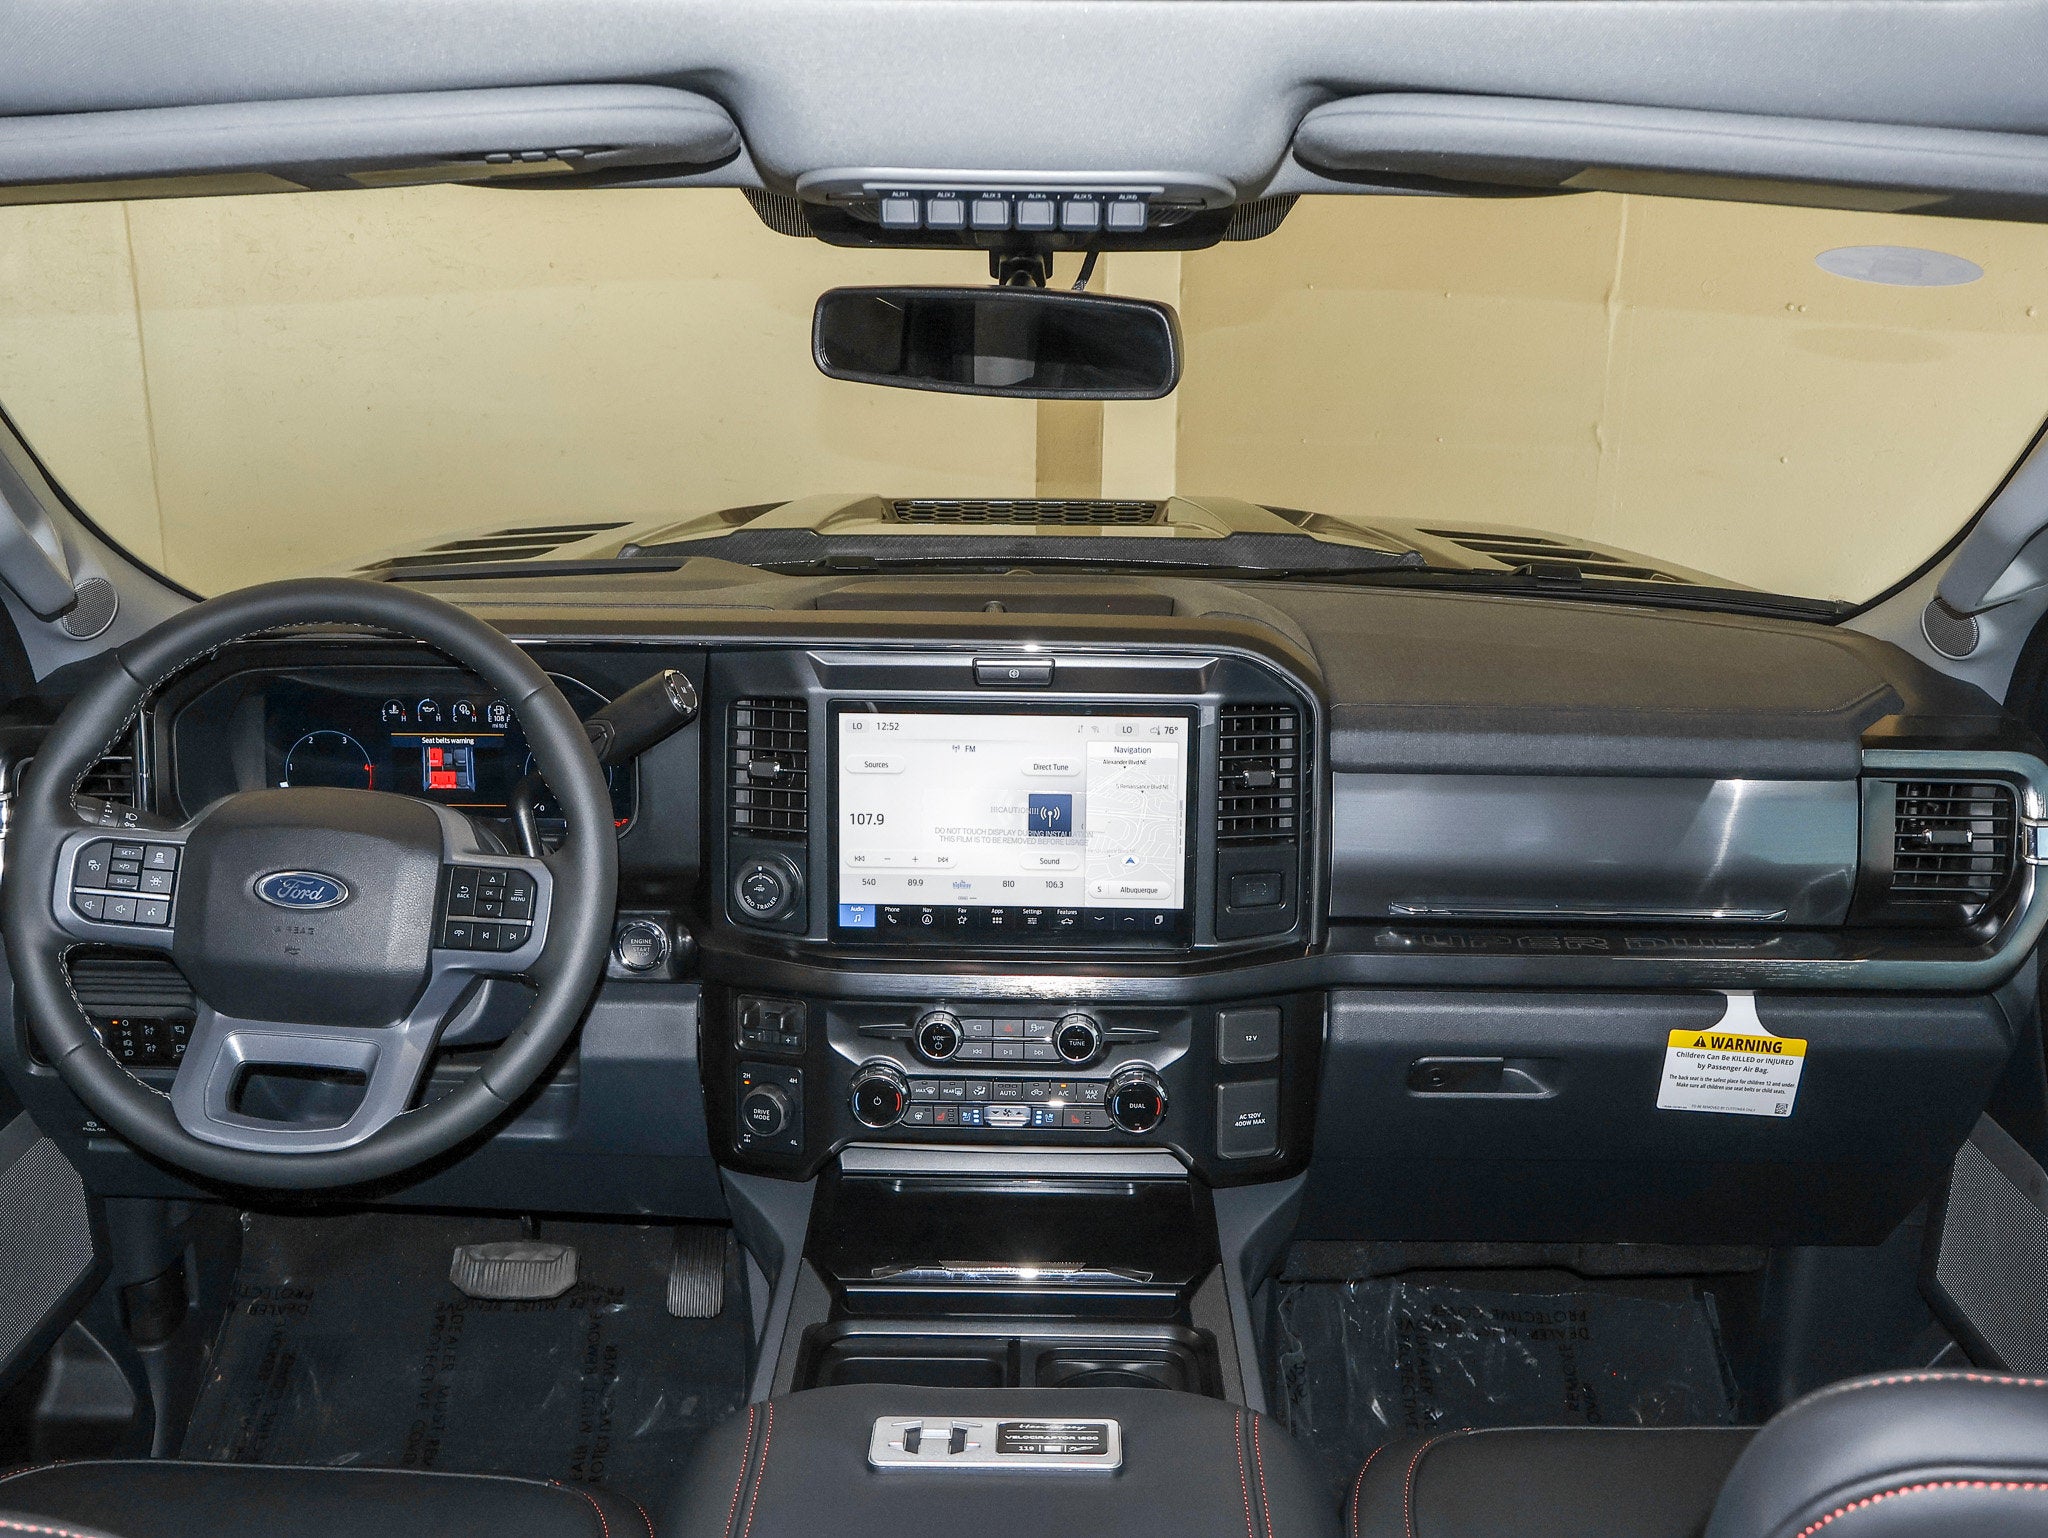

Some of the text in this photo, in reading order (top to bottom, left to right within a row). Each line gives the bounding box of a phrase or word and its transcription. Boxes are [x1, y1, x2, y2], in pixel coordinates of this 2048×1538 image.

[852, 722, 900, 731] LO 12:52
[1122, 726, 1133, 734] LO
[308, 736, 314, 744] 2
[342, 736, 348, 744] 3
[964, 745, 976, 753] FM
[1113, 746, 1152, 755] Navigation
[363, 763, 369, 771] 4
[864, 760, 889, 769] Sources
[1033, 763, 1069, 771] Direct Tune
[850, 813, 885, 826] 107.9
[962, 828, 987, 836] TOUCH
[987, 828, 1016, 836] DISPLAY
[1039, 857, 1060, 865] Sound
[862, 878, 877, 886] 540
[907, 879, 924, 887] 89.9
[1045, 881, 1064, 889] 106.3
[277, 877, 325, 901] Ford
[1120, 886, 1158, 895] Albuquerque
[744, 895, 778, 910] PRO TRAILER
[1022, 908, 1043, 916] Settings
[1710, 1036, 1783, 1054] WARNING
[1676, 1051, 1706, 1060] Children
[1706, 1052, 1720, 1061] Can
[1721, 1053, 1731, 1061] Be
[1731, 1055, 1756, 1063] KILLED
[1765, 1058, 1795, 1067] INJURED
[1697, 1062, 1769, 1075] by Passenger Air Bag.
[1129, 1102, 1146, 1110] DUAL
[753, 1108, 771, 1116] DRIVE
[1234, 1119, 1252, 1127] 400W
